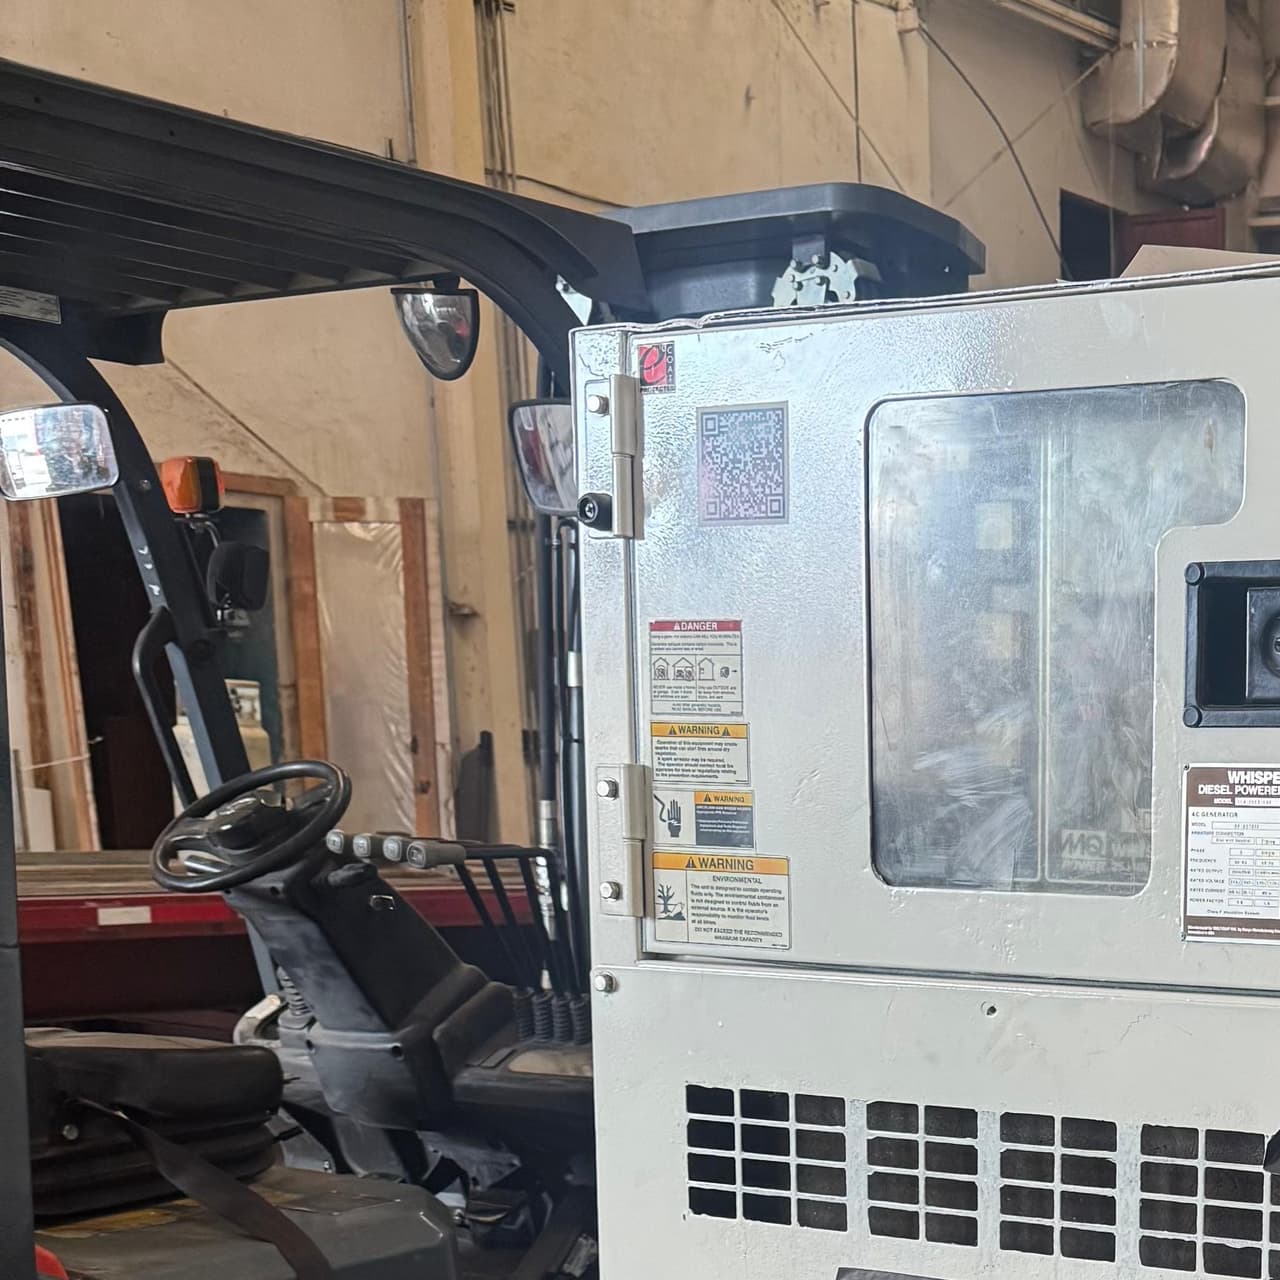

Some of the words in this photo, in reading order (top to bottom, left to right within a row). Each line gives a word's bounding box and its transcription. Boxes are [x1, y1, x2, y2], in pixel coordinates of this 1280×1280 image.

[681, 622, 718, 631] DANGER
[678, 726, 720, 735] WARNING
[1198, 784, 1233, 795] DIESEL
[698, 857, 754, 870] WARNING
